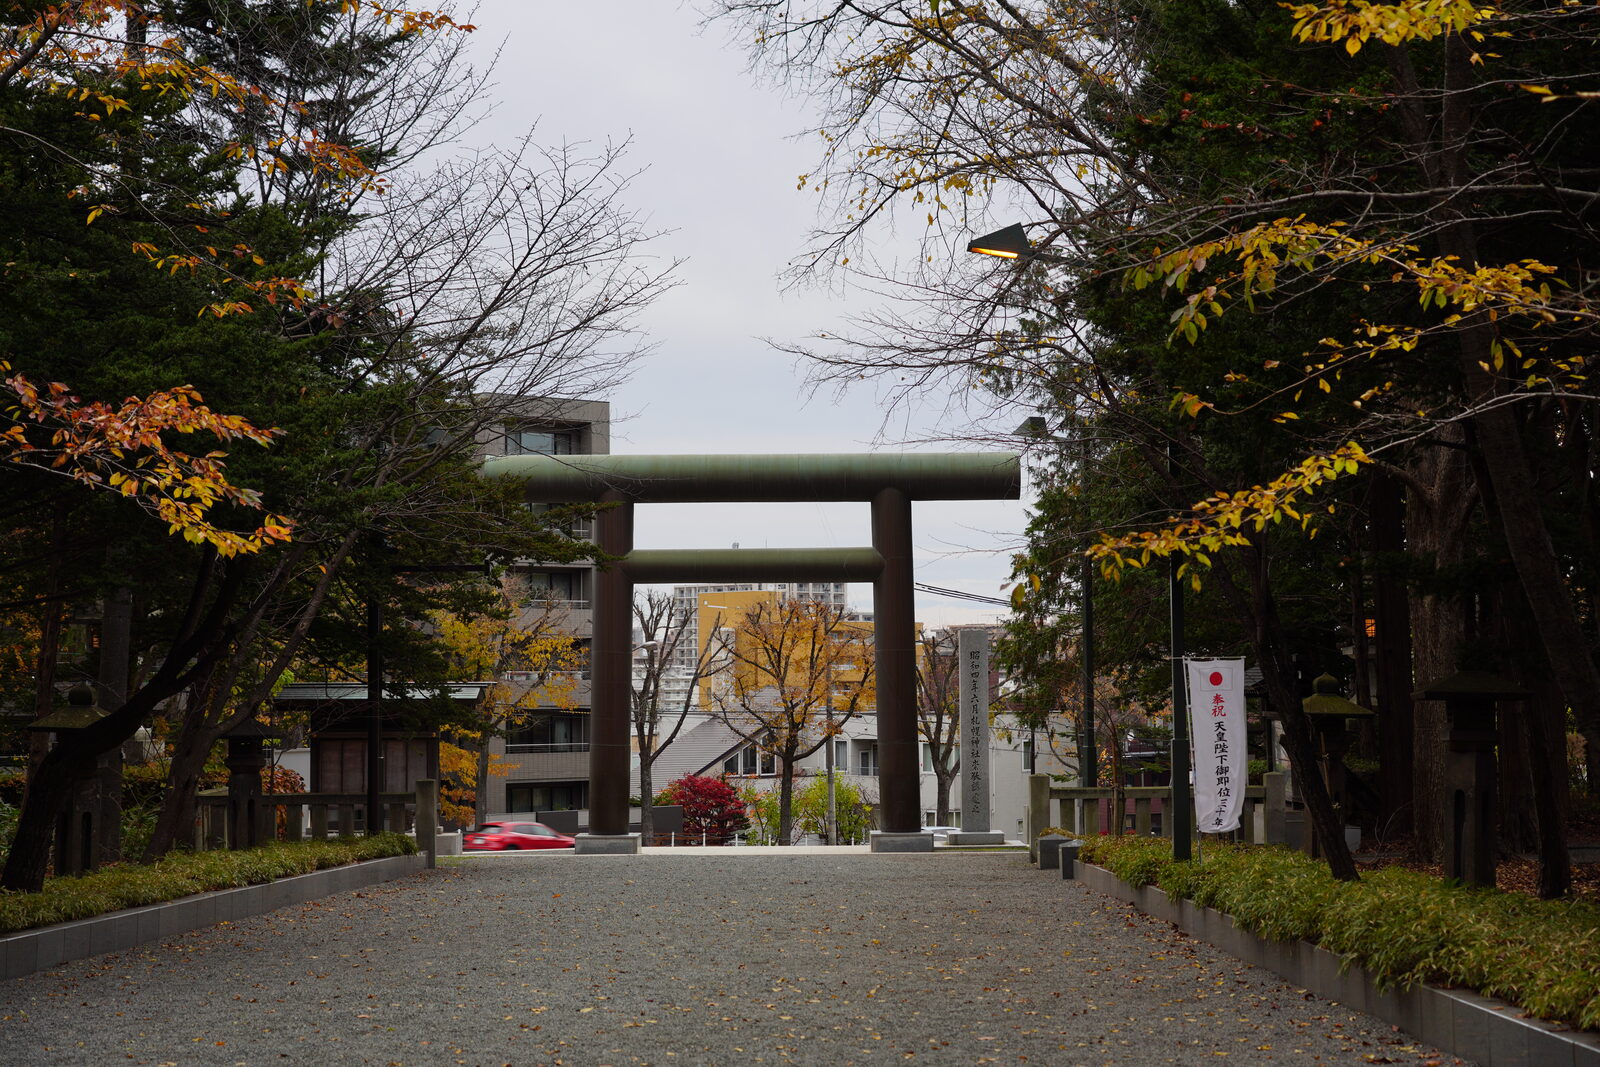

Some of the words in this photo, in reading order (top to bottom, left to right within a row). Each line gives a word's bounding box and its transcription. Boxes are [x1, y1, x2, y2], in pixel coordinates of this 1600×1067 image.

[1211, 693, 1227, 717] 奉祝
[1211, 721, 1231, 827] 天皇陛下御即位三十年
